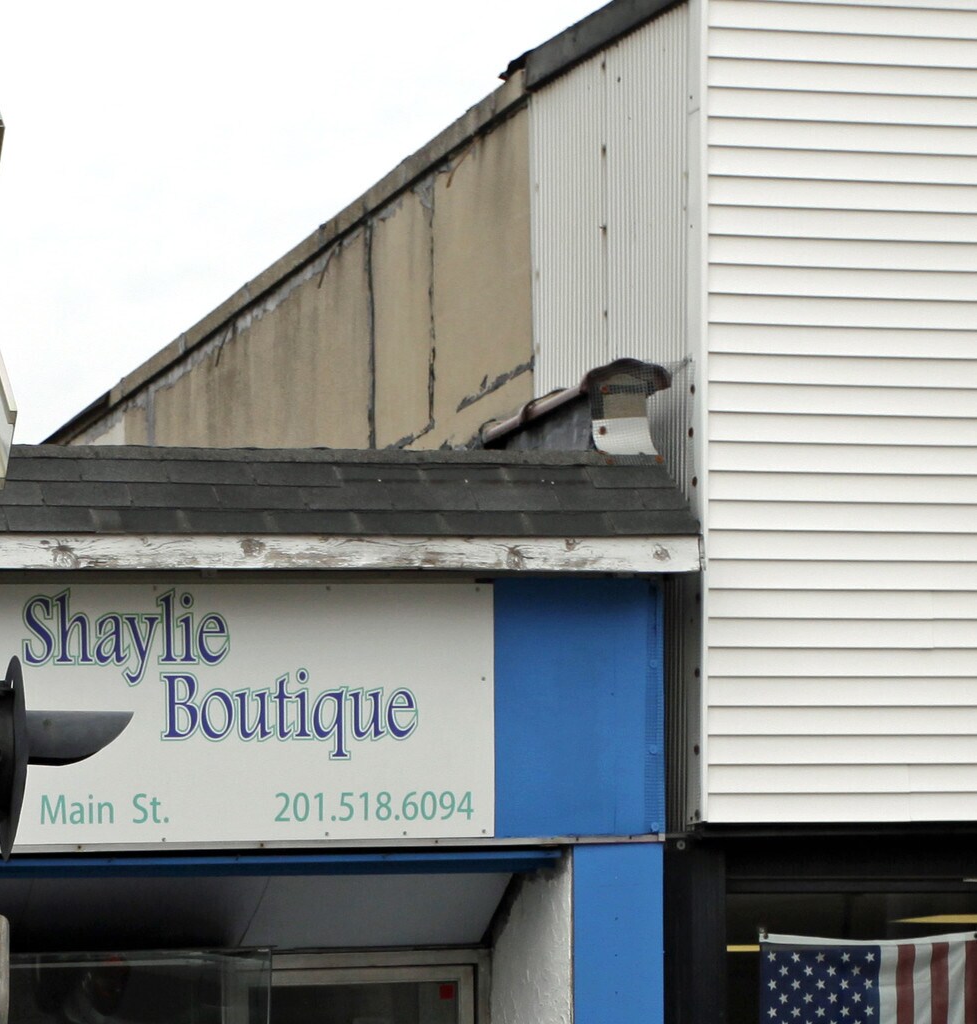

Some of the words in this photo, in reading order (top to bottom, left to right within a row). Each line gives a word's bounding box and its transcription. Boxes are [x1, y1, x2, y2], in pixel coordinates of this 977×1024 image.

[22, 587, 230, 686] Shaylie
[161, 668, 418, 760] Boutique
[40, 794, 115, 825] Main
[132, 793, 169, 824] St.
[274, 790, 474, 824] 201.518.6094
